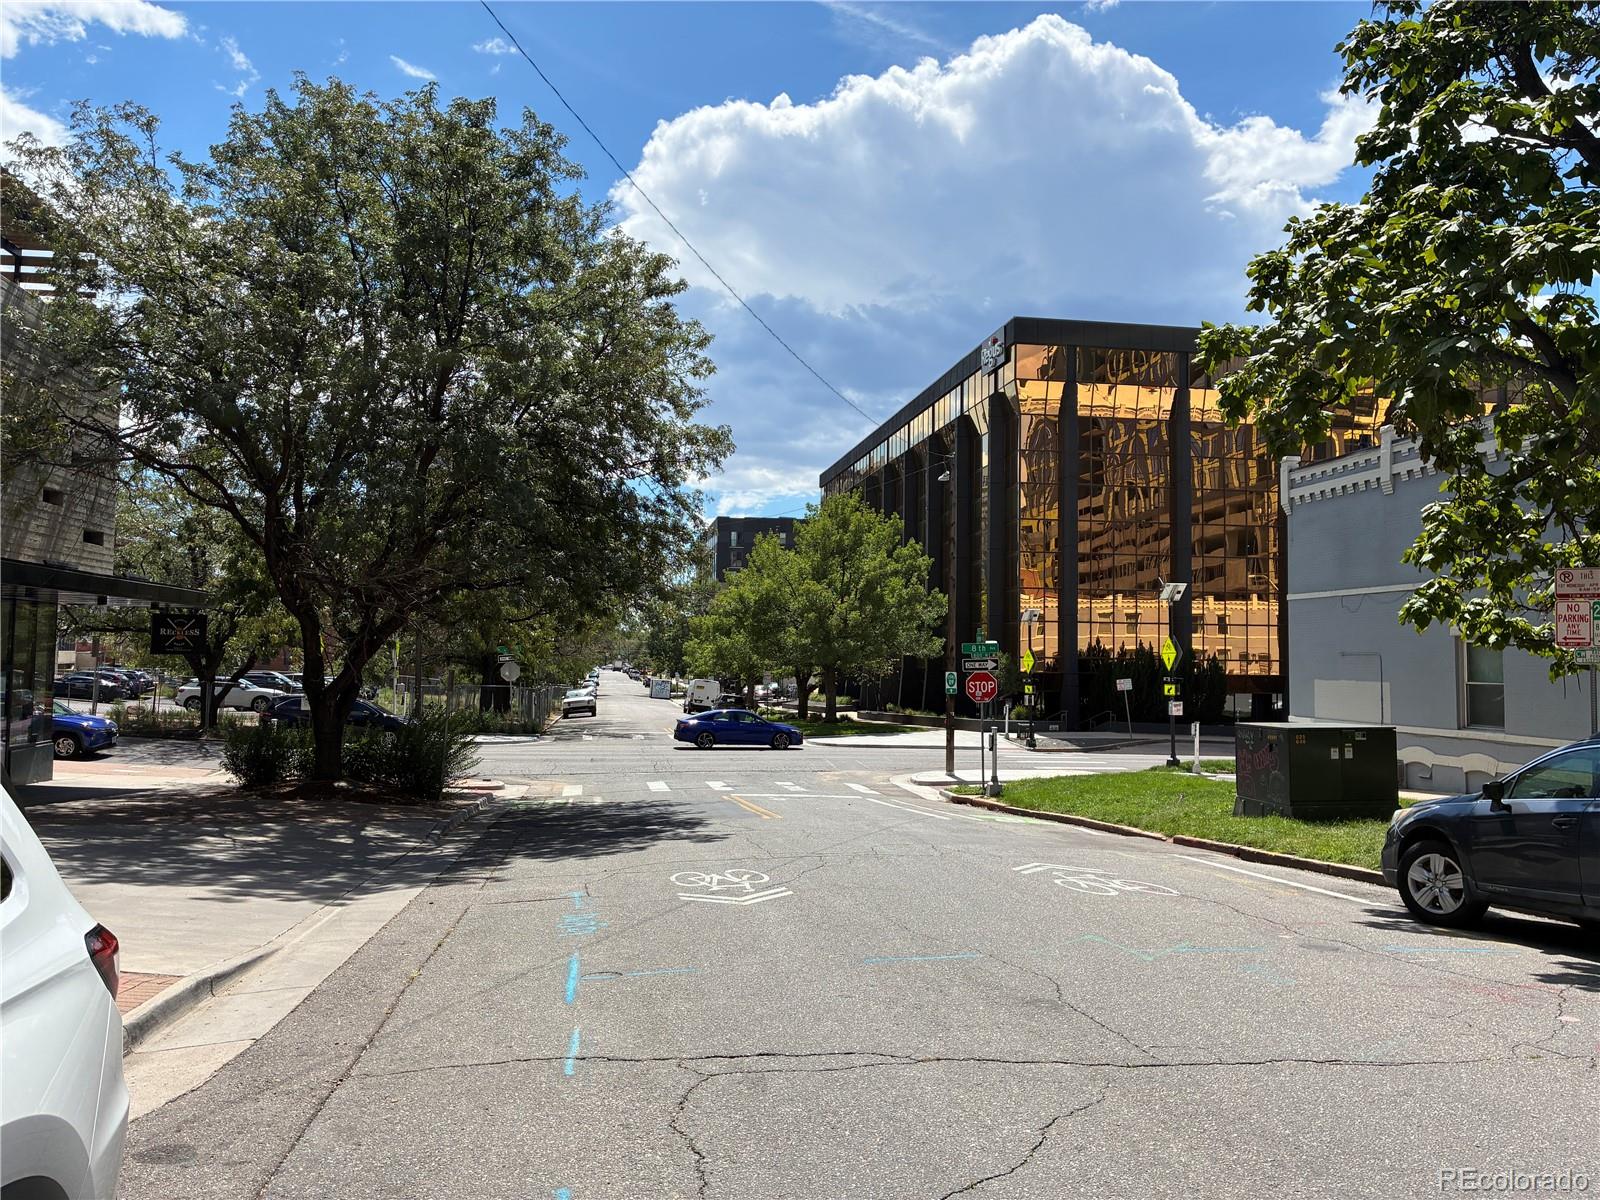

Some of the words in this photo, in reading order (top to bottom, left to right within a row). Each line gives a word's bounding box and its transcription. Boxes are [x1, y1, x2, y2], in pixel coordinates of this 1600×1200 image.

[1566, 604, 1580, 613] NO
[1558, 614, 1589, 623] PARKING
[971, 644, 986, 652] 8th
[968, 681, 995, 693] STOP
